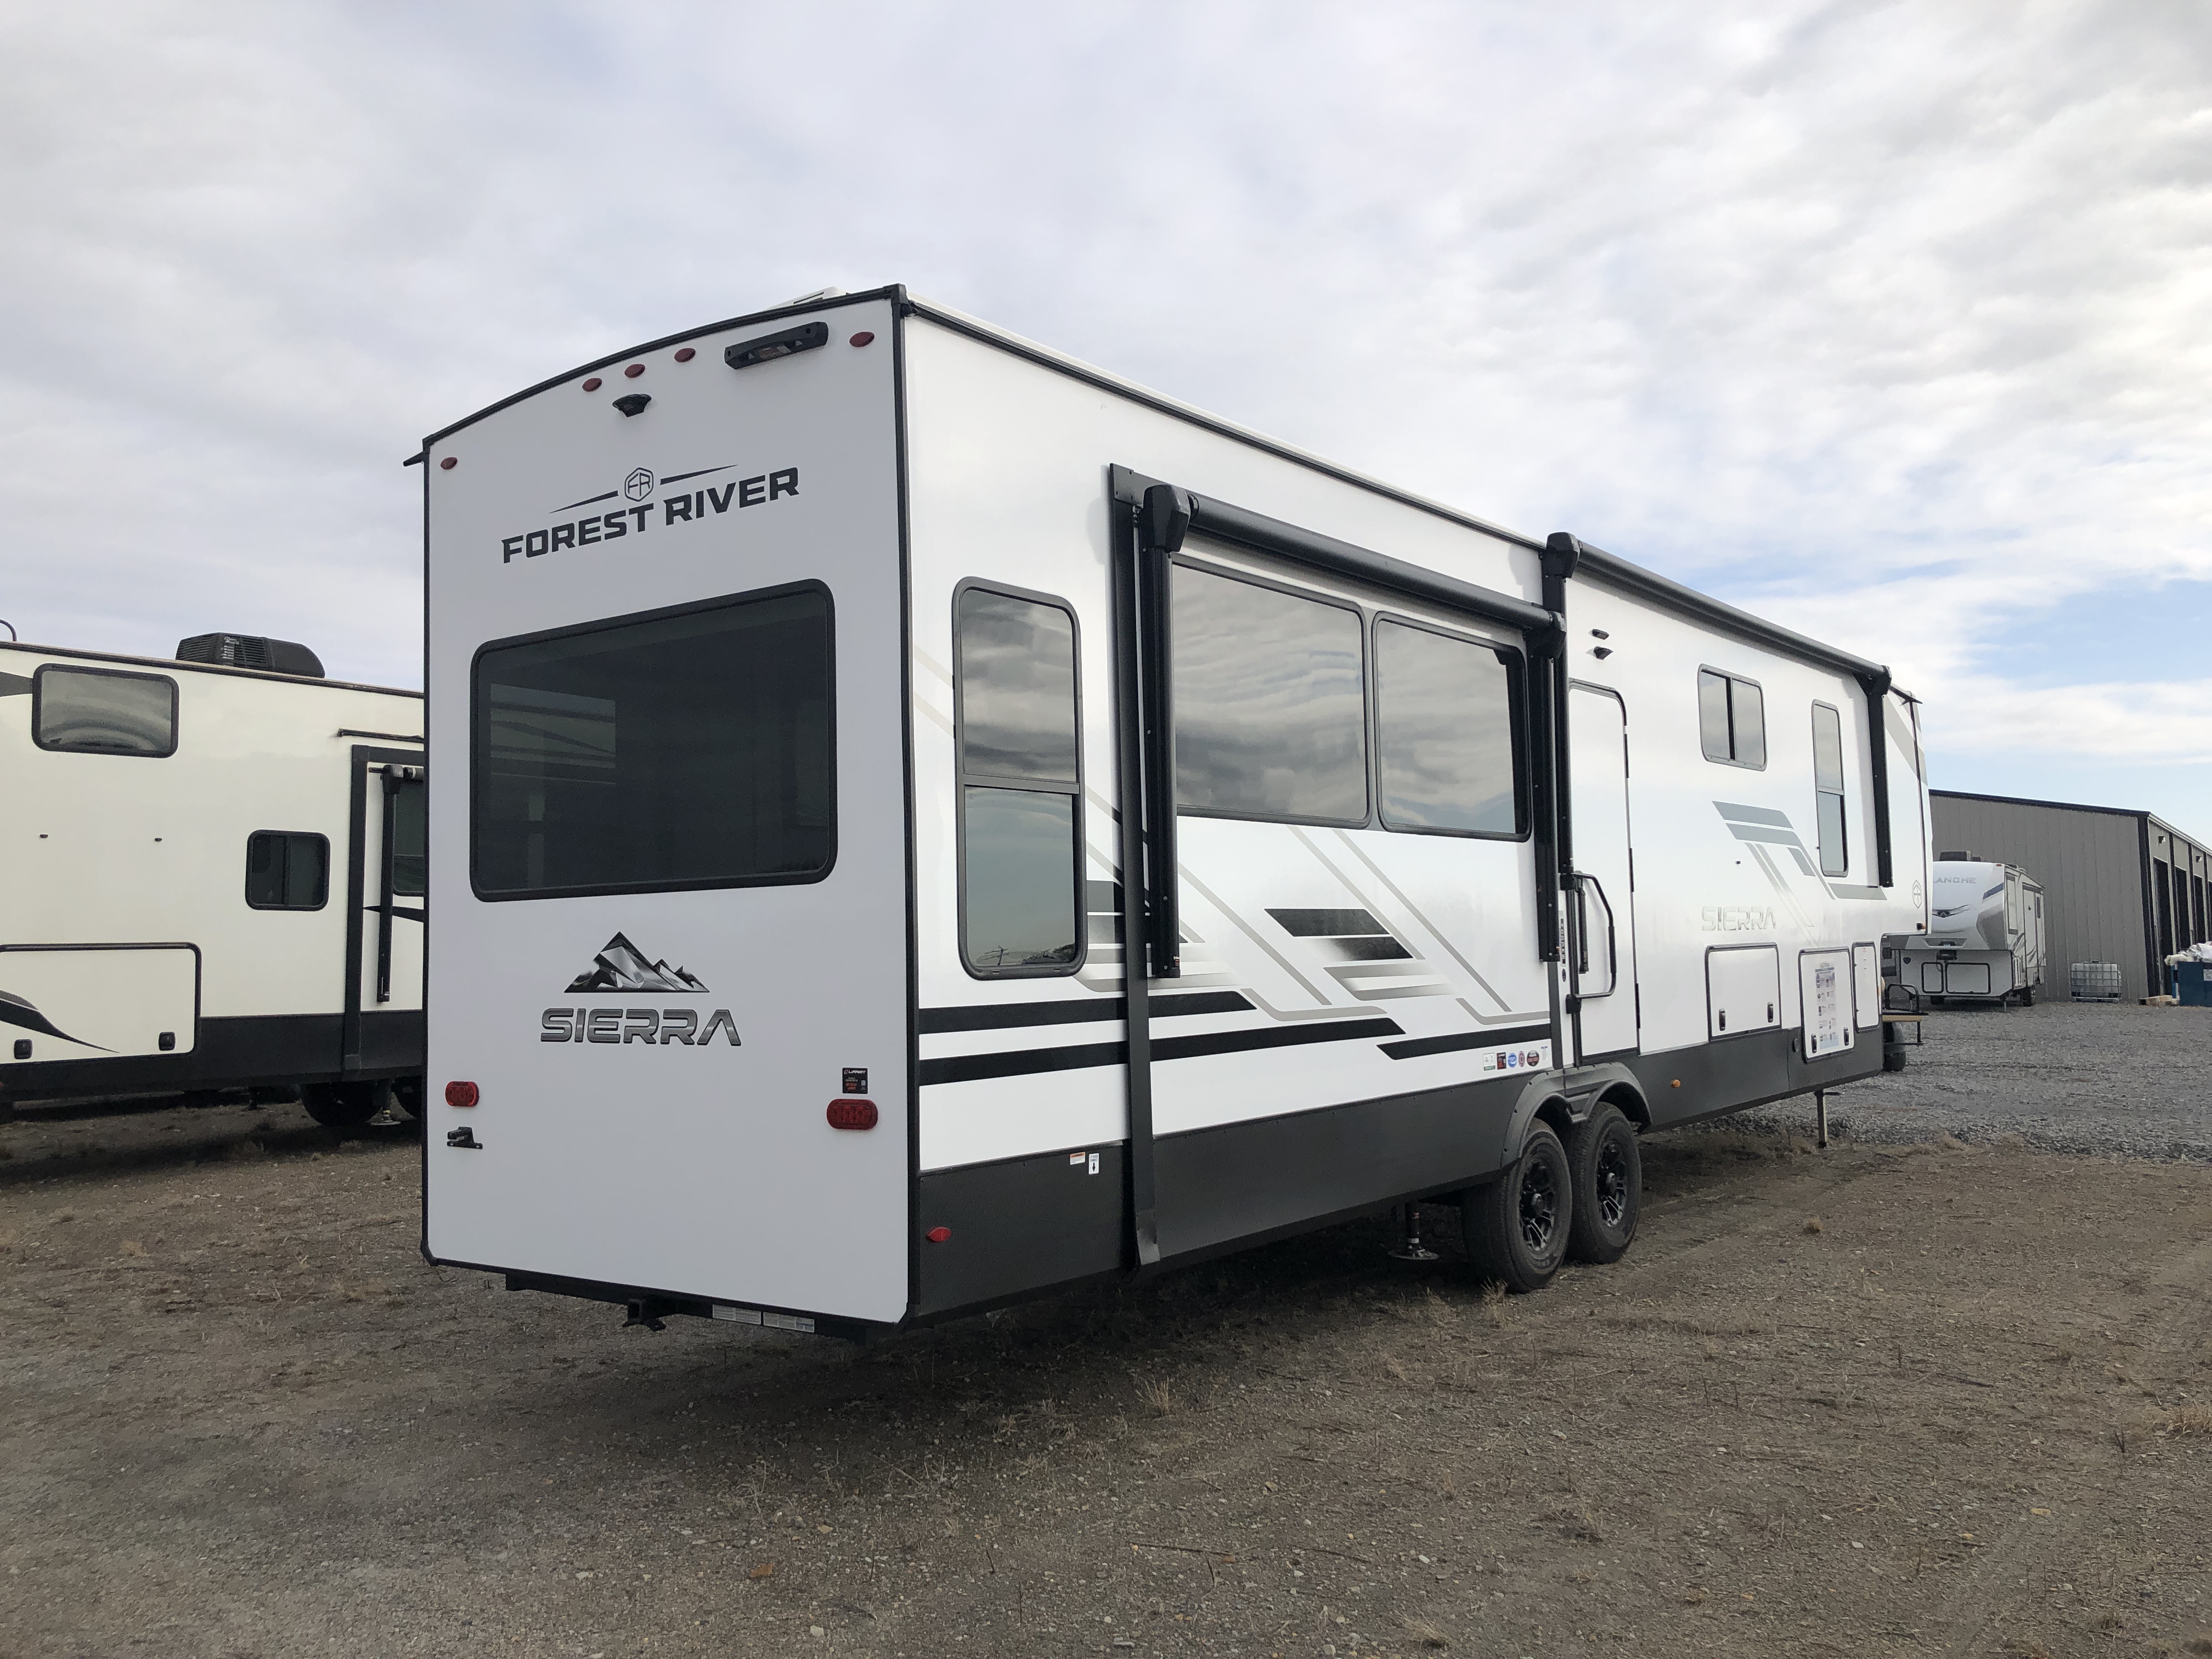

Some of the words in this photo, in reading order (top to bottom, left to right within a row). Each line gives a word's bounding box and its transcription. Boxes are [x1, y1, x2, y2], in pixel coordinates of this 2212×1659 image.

[501, 503, 654, 564] FOREST
[663, 467, 800, 526] RIVER
[1702, 906, 1777, 932] SIERRA
[540, 1008, 742, 1047] SIERRA
